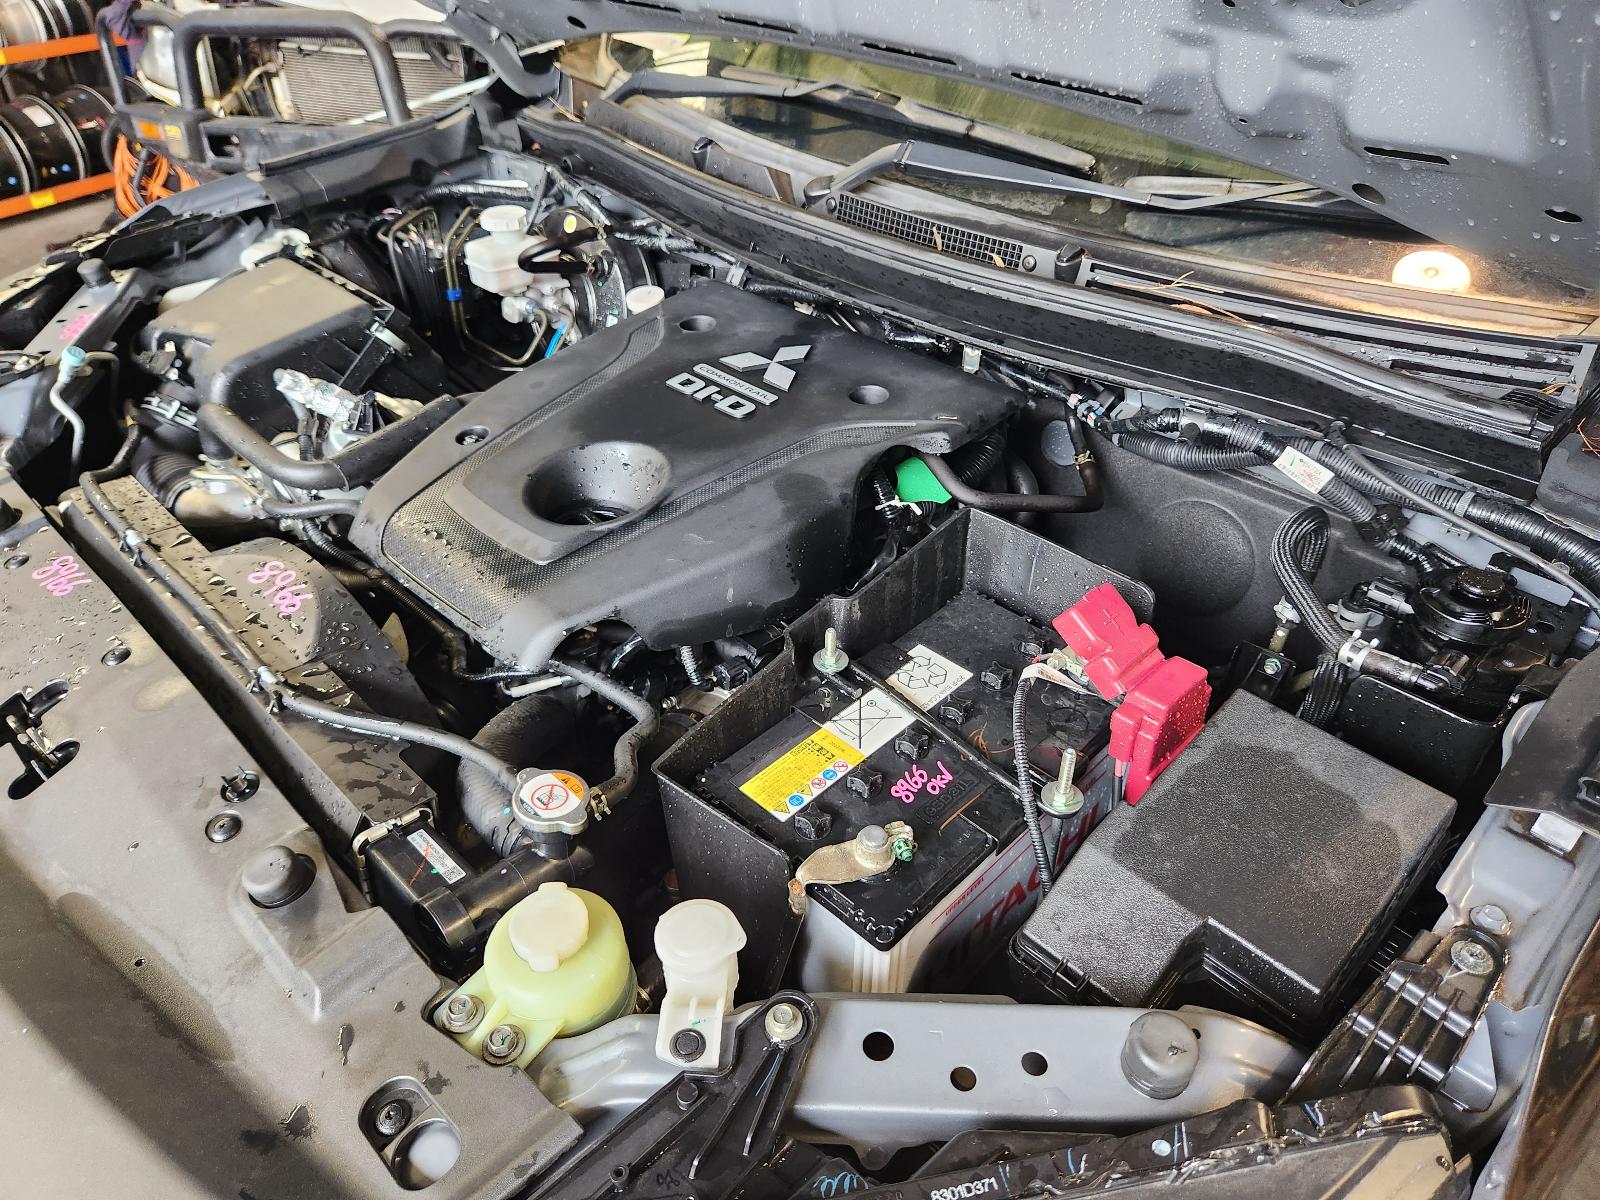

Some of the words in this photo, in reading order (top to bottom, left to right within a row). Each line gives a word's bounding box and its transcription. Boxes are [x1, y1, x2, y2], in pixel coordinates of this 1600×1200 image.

[665, 372, 756, 419] DI-D
[698, 365, 744, 389] COMMON
[744, 383, 771, 401] RAIL
